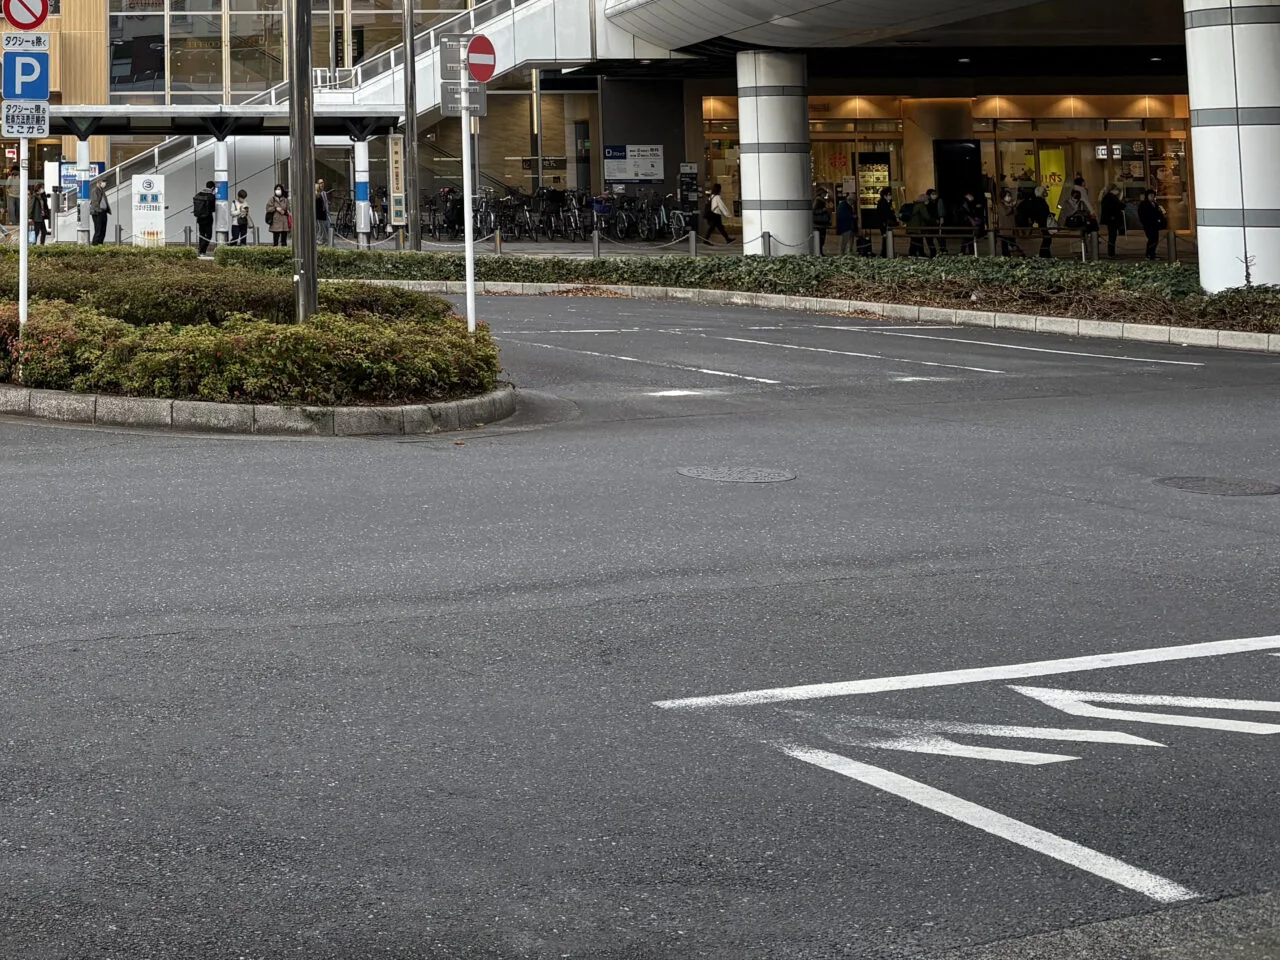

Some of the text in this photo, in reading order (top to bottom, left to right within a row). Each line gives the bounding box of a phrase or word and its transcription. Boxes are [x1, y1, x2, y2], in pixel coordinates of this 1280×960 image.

[5, 36, 46, 47] タクシーを除く
[15, 56, 41, 95] P
[6, 104, 46, 114] タクシーに限る
[7, 125, 45, 134] ここから
